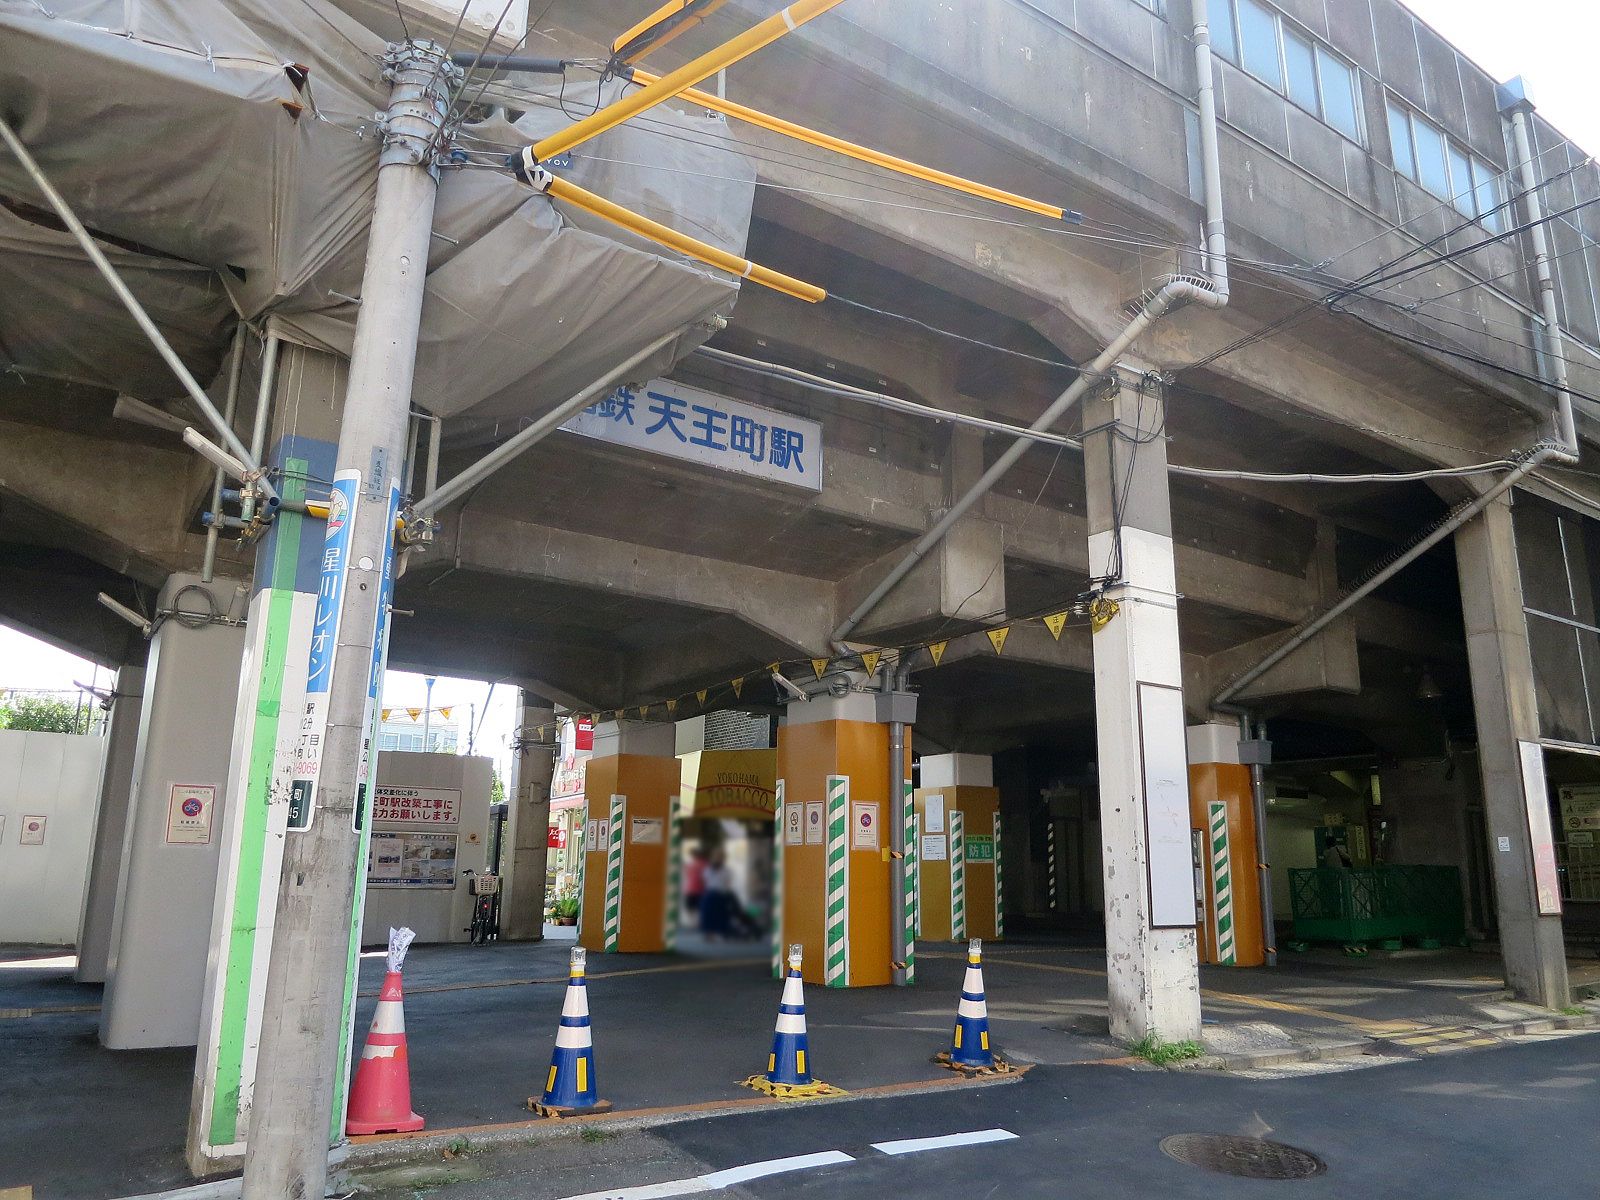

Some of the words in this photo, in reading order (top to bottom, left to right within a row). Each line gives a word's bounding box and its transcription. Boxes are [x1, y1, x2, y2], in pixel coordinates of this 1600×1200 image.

[645, 391, 804, 473] 天王町駅
[308, 547, 341, 681] 星川レオン
[717, 772, 760, 786] YOKOHAMA
